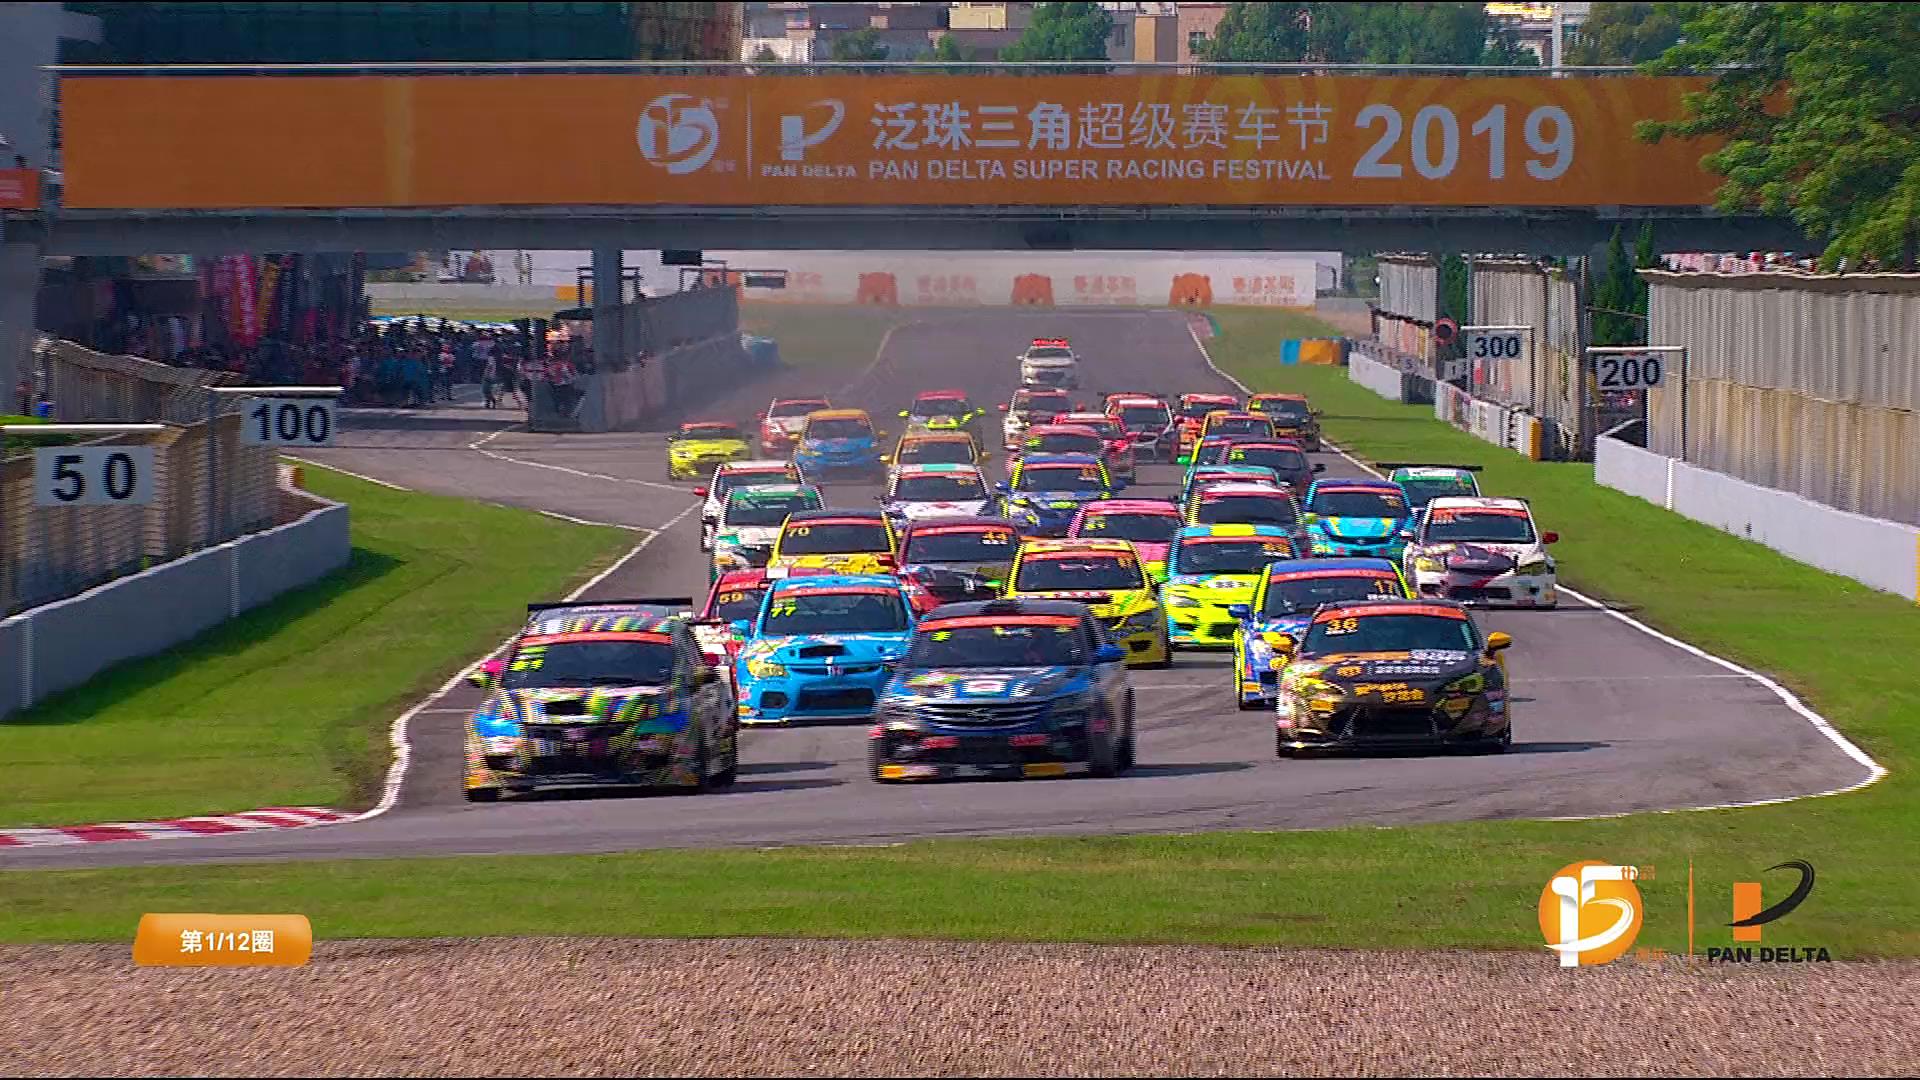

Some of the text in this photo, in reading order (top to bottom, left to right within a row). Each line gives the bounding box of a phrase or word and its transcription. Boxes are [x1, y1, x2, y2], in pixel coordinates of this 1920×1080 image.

[871, 102, 1332, 151] 泛珠三角超级赛车节
[1353, 104, 1574, 180] 2019
[761, 164, 857, 177] PAN DELTA
[869, 159, 1331, 181] PAN DELTA SUPER RACING FESTIVAL
[1475, 336, 1521, 358] 300
[1601, 358, 1660, 387] 200
[249, 403, 331, 443] 100
[51, 452, 137, 501] 50
[787, 528, 810, 537] 70
[771, 606, 796, 618] 77
[1327, 618, 1358, 631] 36
